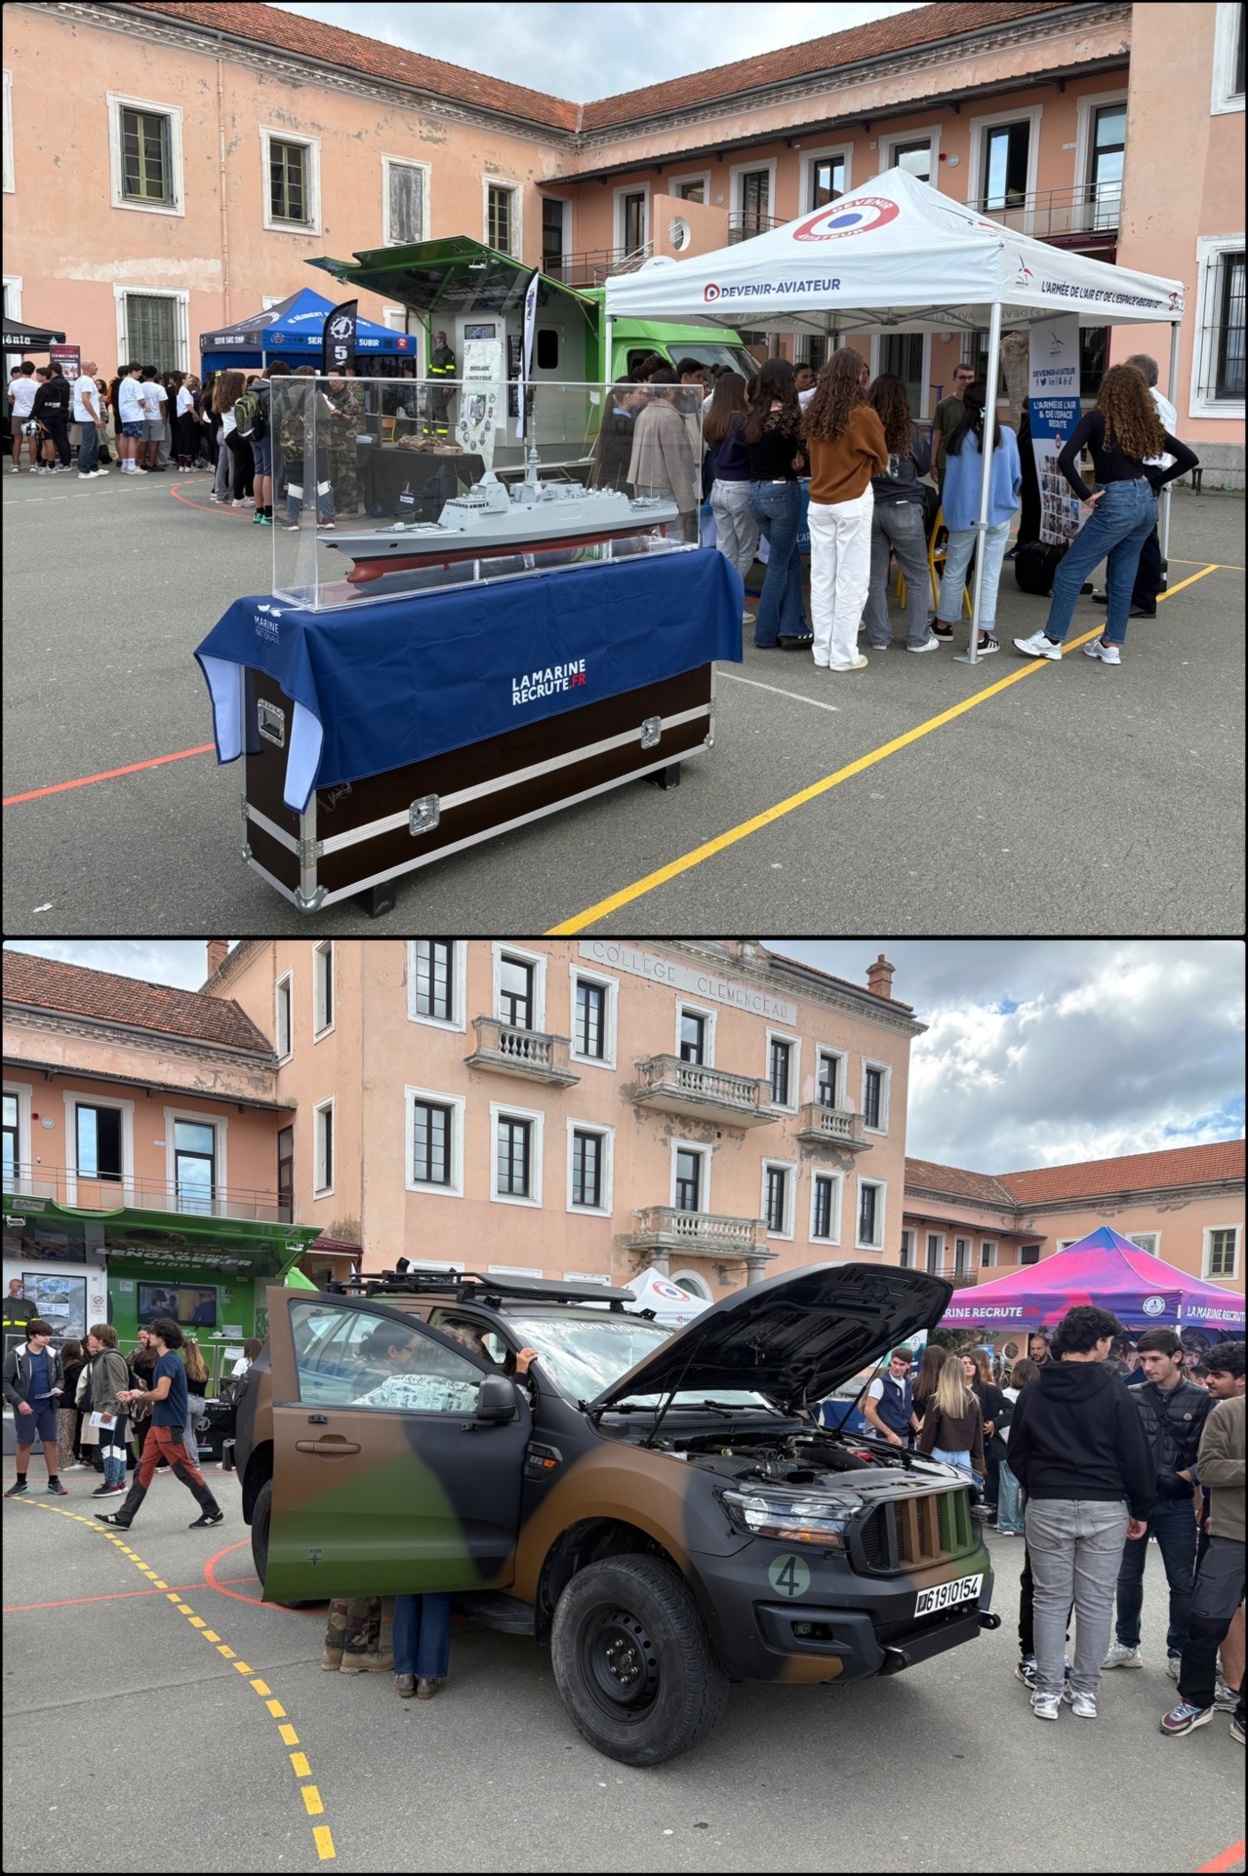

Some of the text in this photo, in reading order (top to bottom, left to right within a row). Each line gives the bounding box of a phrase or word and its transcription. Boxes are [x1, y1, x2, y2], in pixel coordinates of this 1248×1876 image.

[832, 198, 893, 213] DEVENIR
[721, 278, 841, 298] DEVENIR-AVIATEUR
[1041, 280, 1069, 297] L'ARMÉE
[1069, 285, 1080, 298] DE
[1080, 287, 1094, 301] L'AIR
[358, 338, 380, 347] SUBIR
[253, 615, 279, 634] MARINE
[512, 673, 587, 706] RECRUTE.FR
[943, 1307, 970, 1318] RINE
[1195, 1306, 1223, 1320] MARINE
[1222, 1308, 1246, 1323] RECRUT
[775, 1556, 800, 1596] 4
[926, 1576, 979, 1611] 61910154
